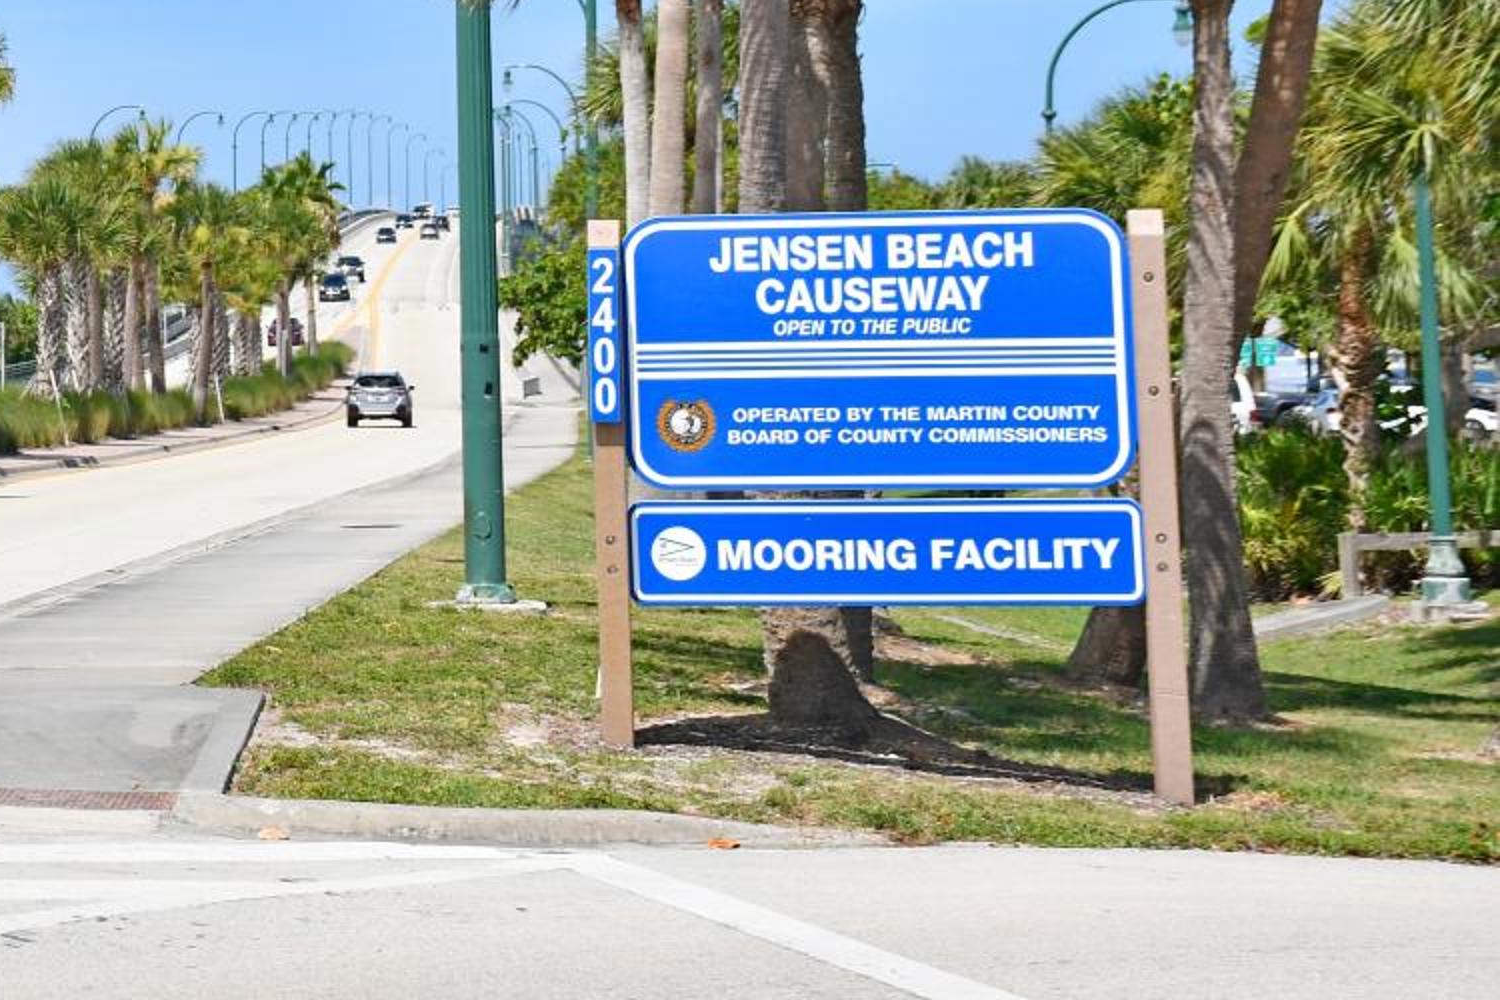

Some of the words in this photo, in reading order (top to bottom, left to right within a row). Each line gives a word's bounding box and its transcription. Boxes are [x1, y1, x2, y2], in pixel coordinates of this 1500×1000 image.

[709, 235, 873, 273] JENSEN
[887, 231, 1034, 269] BEACH
[755, 275, 989, 314] CAUSEWAY
[591, 257, 617, 414] 2400
[773, 319, 825, 336] OPEN
[830, 319, 856, 335] TO
[861, 318, 897, 335] THE
[902, 317, 972, 334] PUBLIC
[732, 407, 841, 423] OPERATED
[846, 407, 874, 422] BY
[879, 407, 921, 421] THE
[926, 406, 1007, 421] MARTIN
[1012, 405, 1100, 420] COUNTY
[727, 429, 799, 445] BOARD
[804, 429, 832, 444] OF
[837, 428, 924, 443] COUNTY
[928, 427, 1108, 443] COMMISSIONERS
[717, 539, 917, 571] MOORING
[931, 538, 1120, 570] FACILITY
